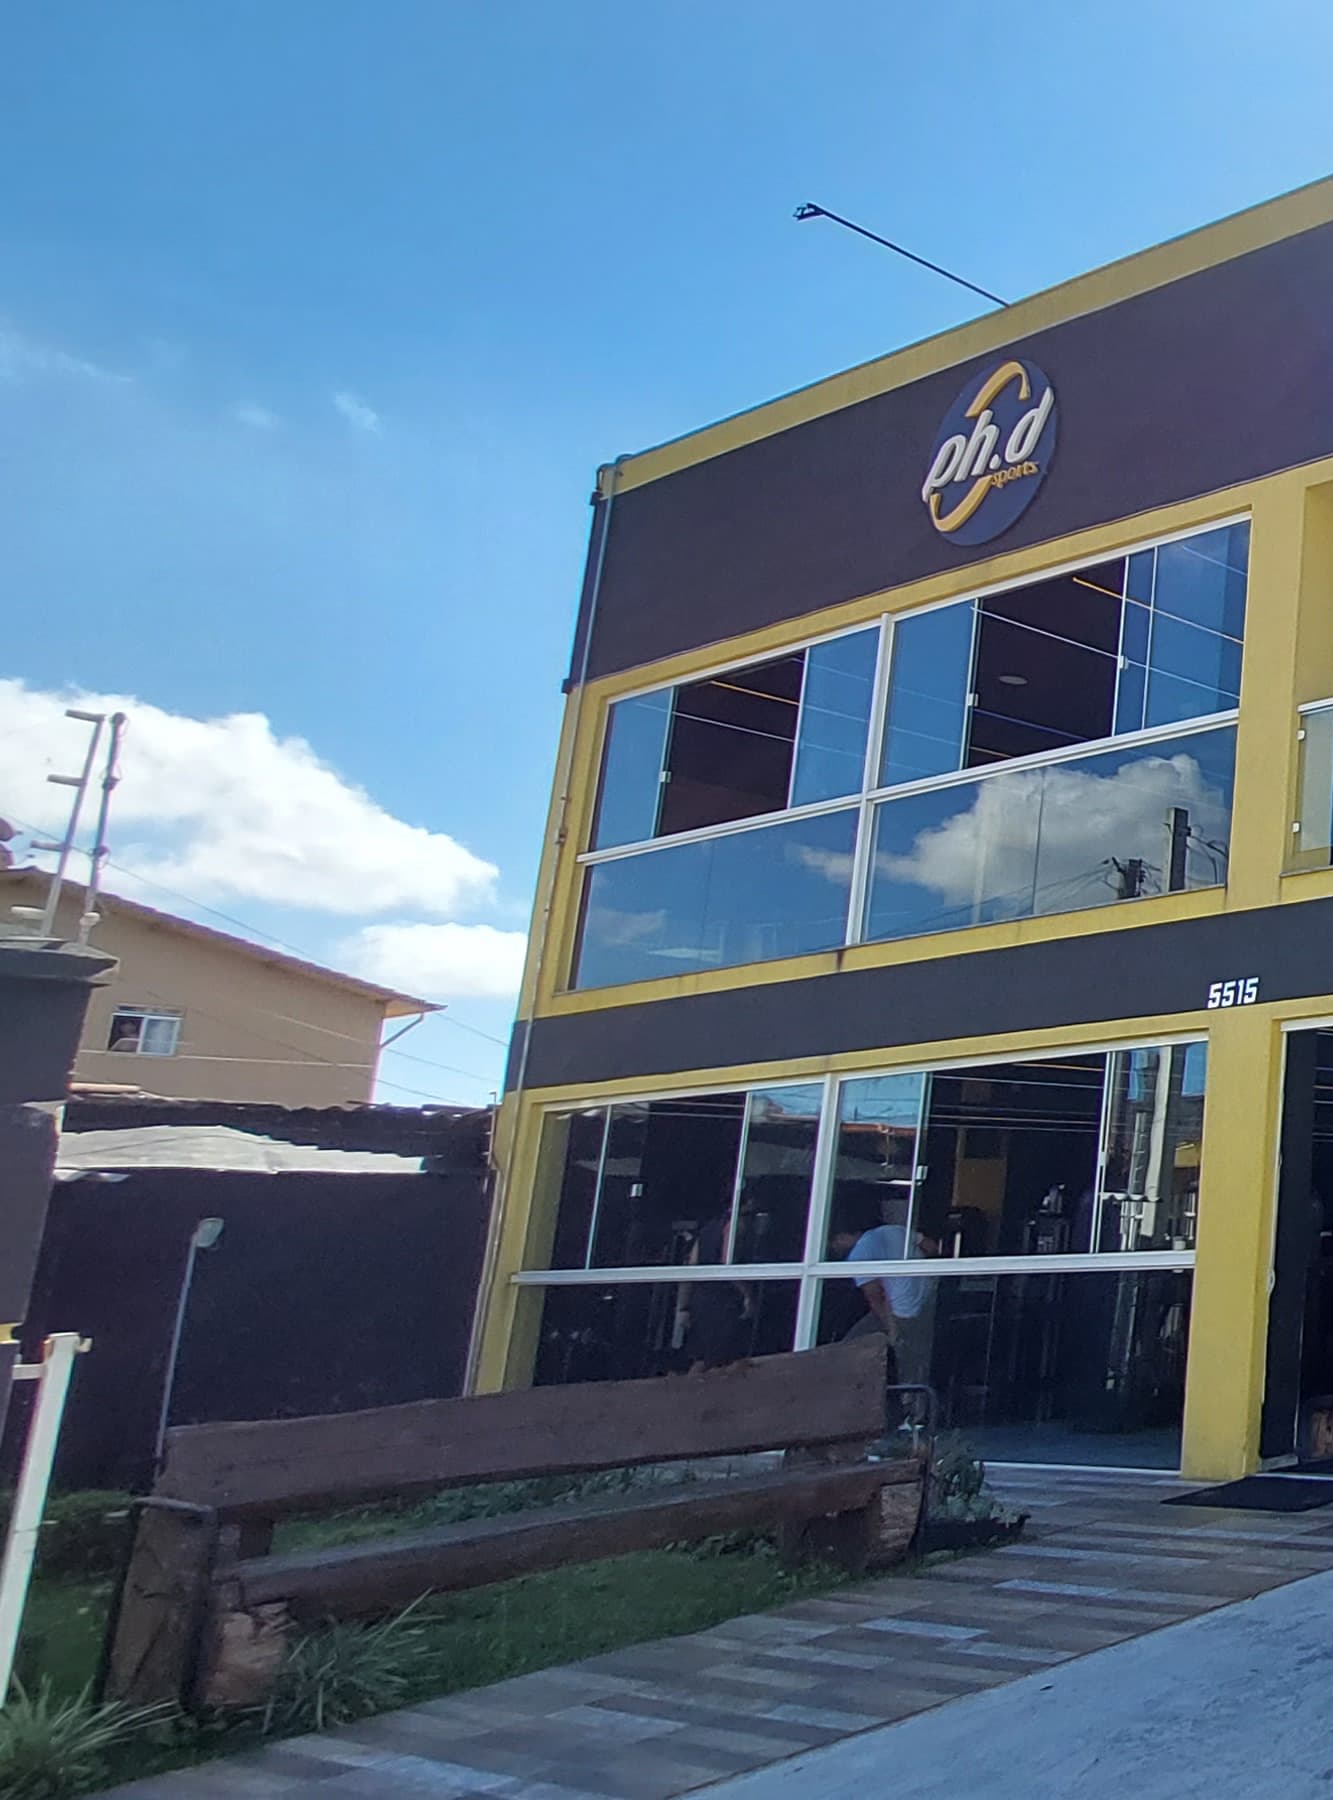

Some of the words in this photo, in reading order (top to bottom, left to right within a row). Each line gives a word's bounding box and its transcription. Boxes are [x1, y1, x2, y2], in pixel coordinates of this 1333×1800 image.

[921, 386, 1054, 502] ph.d
[989, 461, 1041, 489] sports
[1207, 976, 1260, 1009] 5515
